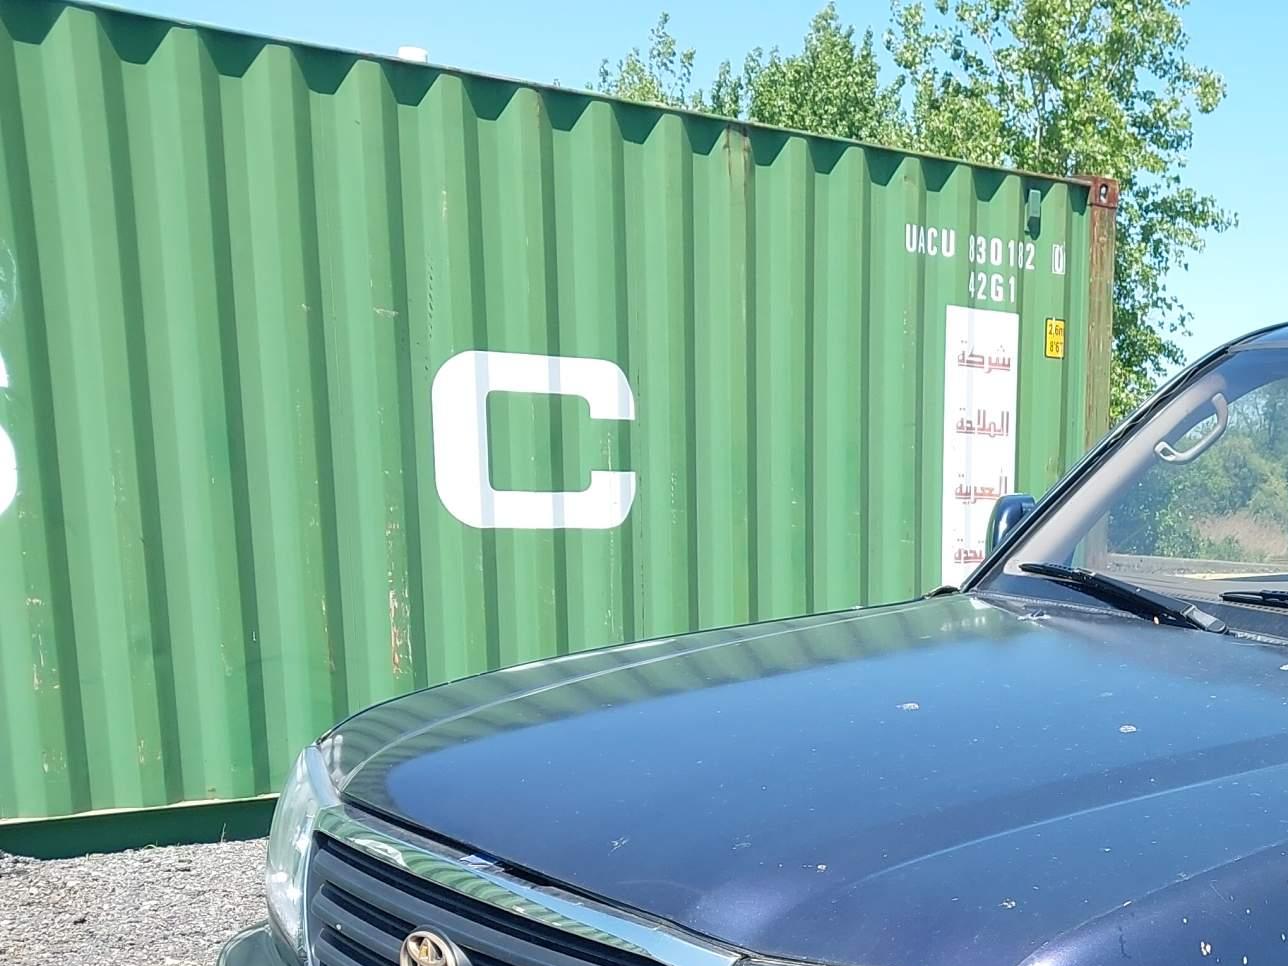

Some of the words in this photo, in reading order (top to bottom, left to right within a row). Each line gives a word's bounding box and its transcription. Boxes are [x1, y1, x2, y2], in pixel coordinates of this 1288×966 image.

[905, 223, 956, 257] UACU
[968, 233, 1036, 271] 830182
[968, 271, 1016, 304] 42G1
[957, 340, 1012, 374] شركة
[955, 408, 1010, 438] الملاحة
